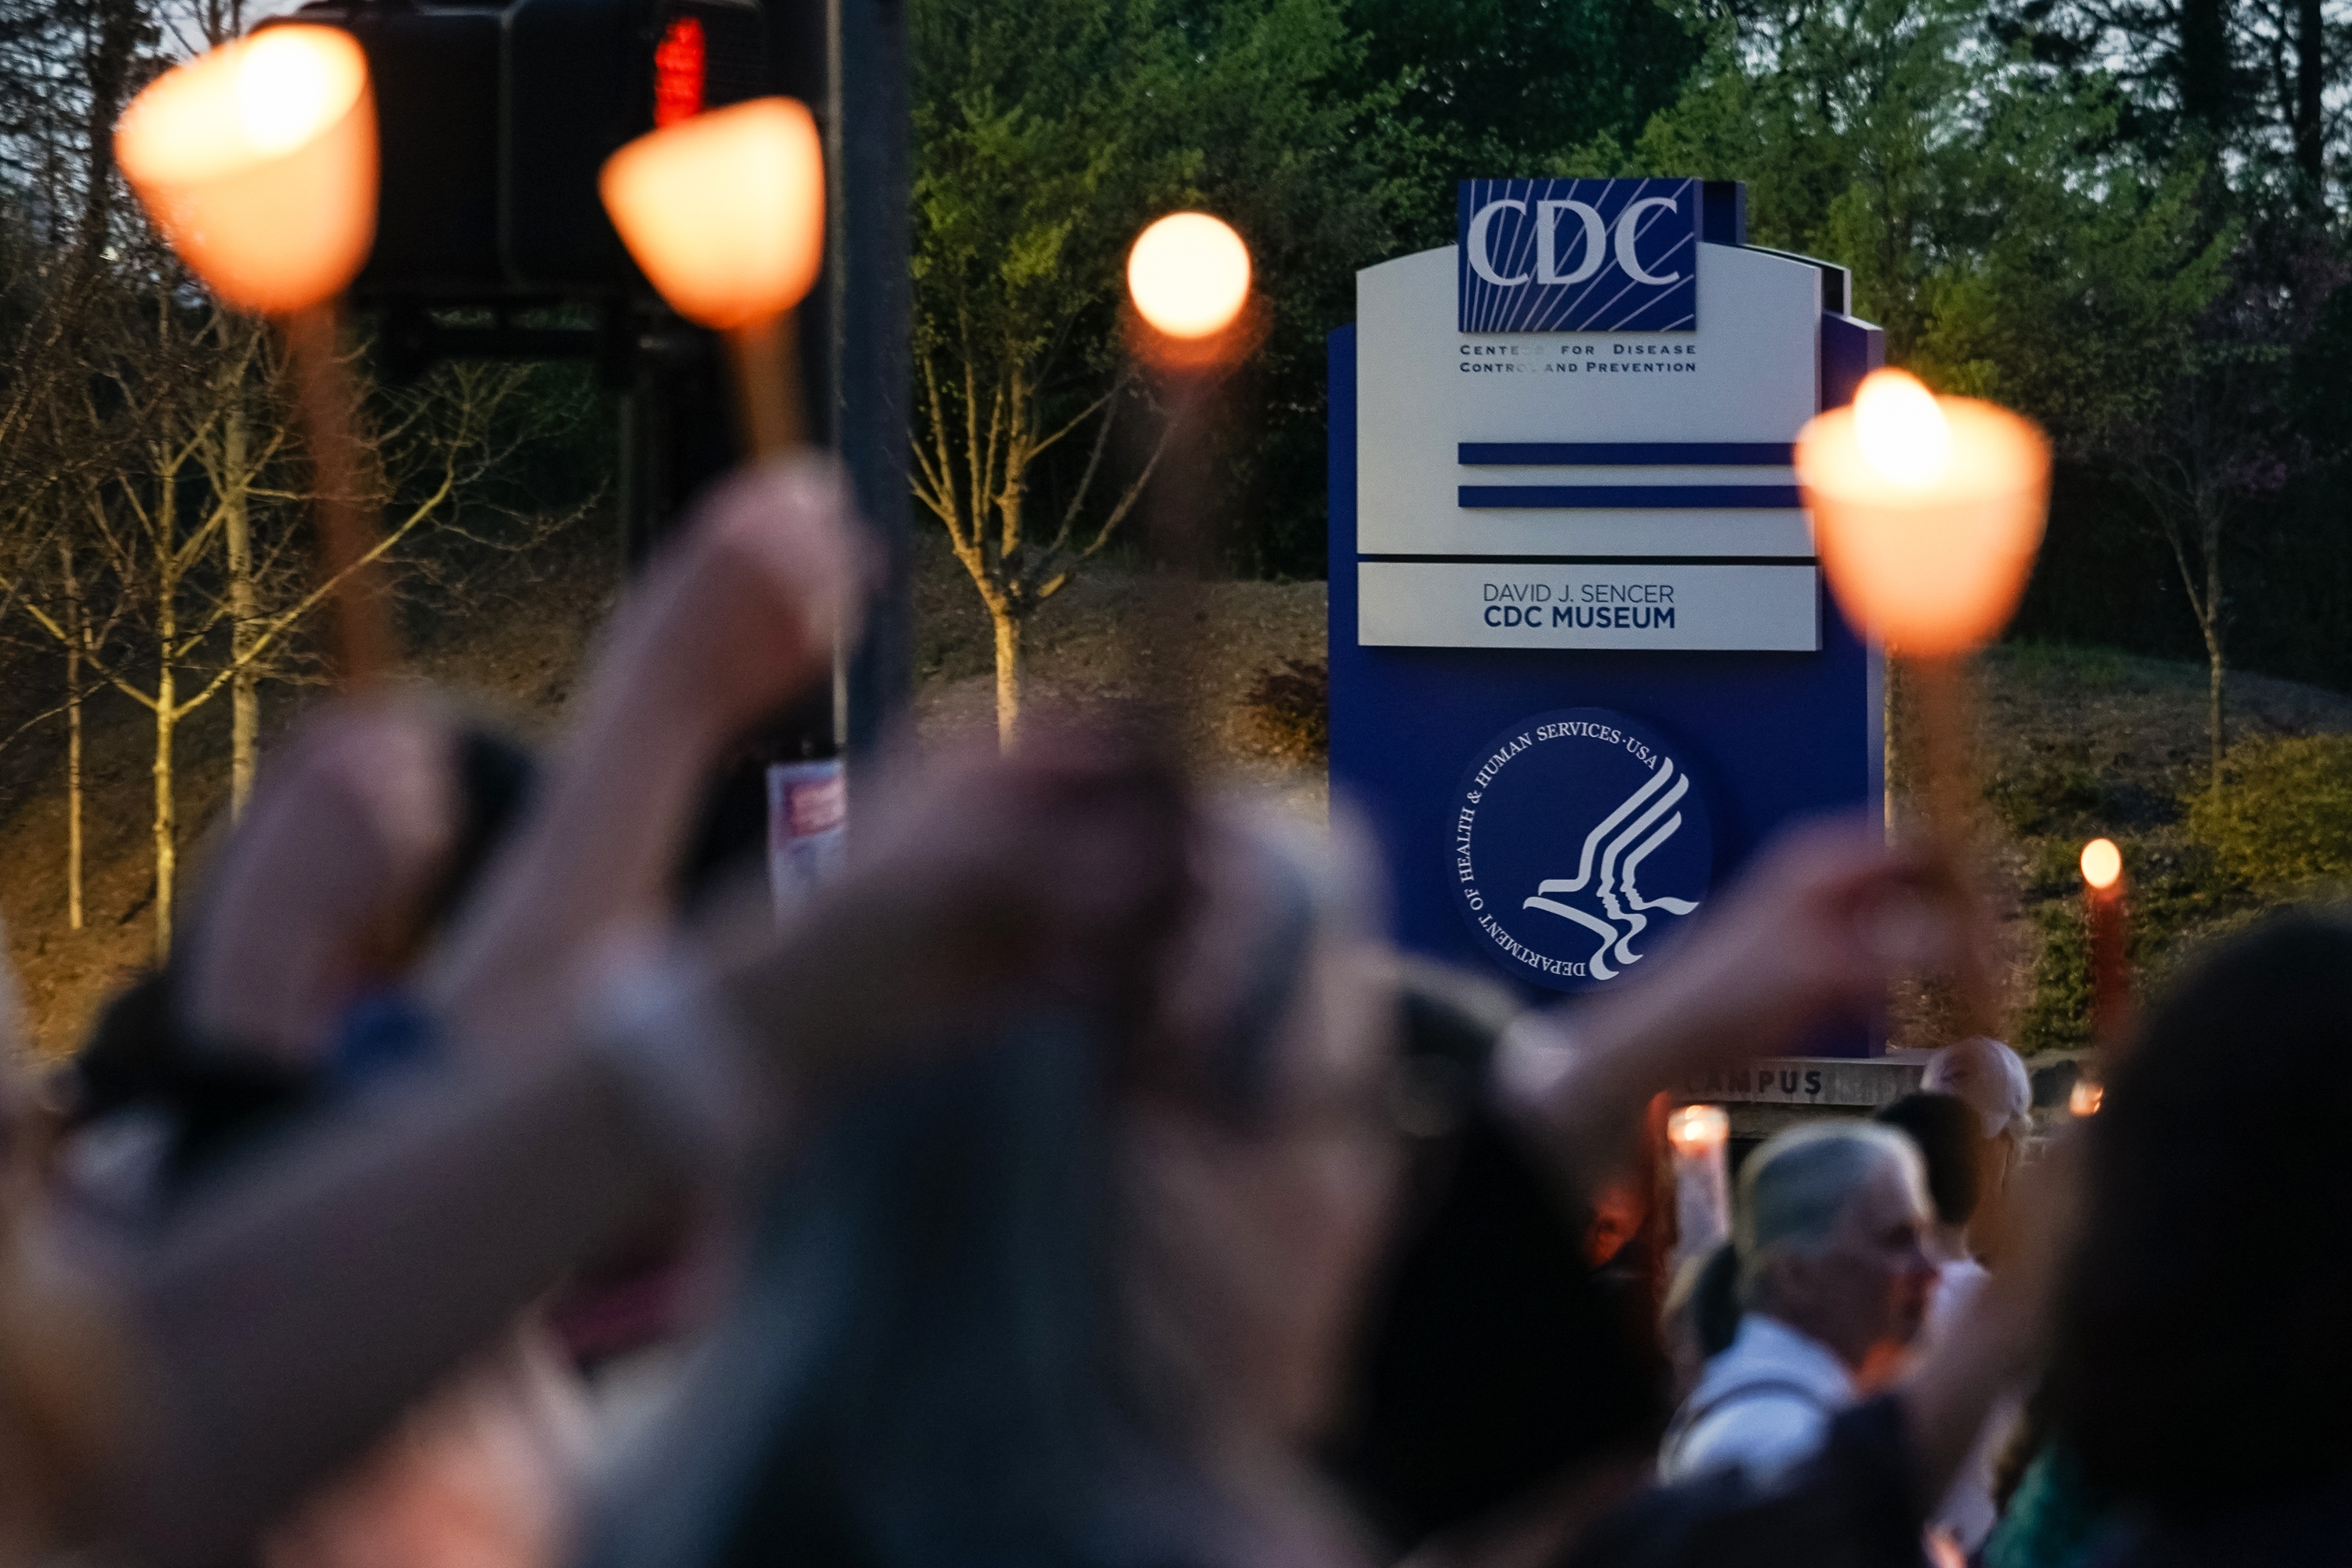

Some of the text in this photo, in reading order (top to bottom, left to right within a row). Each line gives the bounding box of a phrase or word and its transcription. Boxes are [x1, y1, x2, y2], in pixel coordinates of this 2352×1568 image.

[1468, 197, 1680, 286] CDC
[1459, 343, 1697, 356] CENTE FOR DISEASE
[1544, 363, 1578, 372] AND
[1587, 361, 1697, 373] PREVENTION
[1483, 583, 1675, 604] DAVID J. SENCER
[1483, 605, 1675, 629] CDC MUSEUM
[1536, 721, 1621, 744] SERVICES
[1474, 732, 1533, 788] HUMAN
[1466, 790, 1483, 804] &
[1457, 807, 1476, 883] HEALTH
[1465, 888, 1484, 911] OF
[1478, 913, 1587, 977] DEPARTMENT
